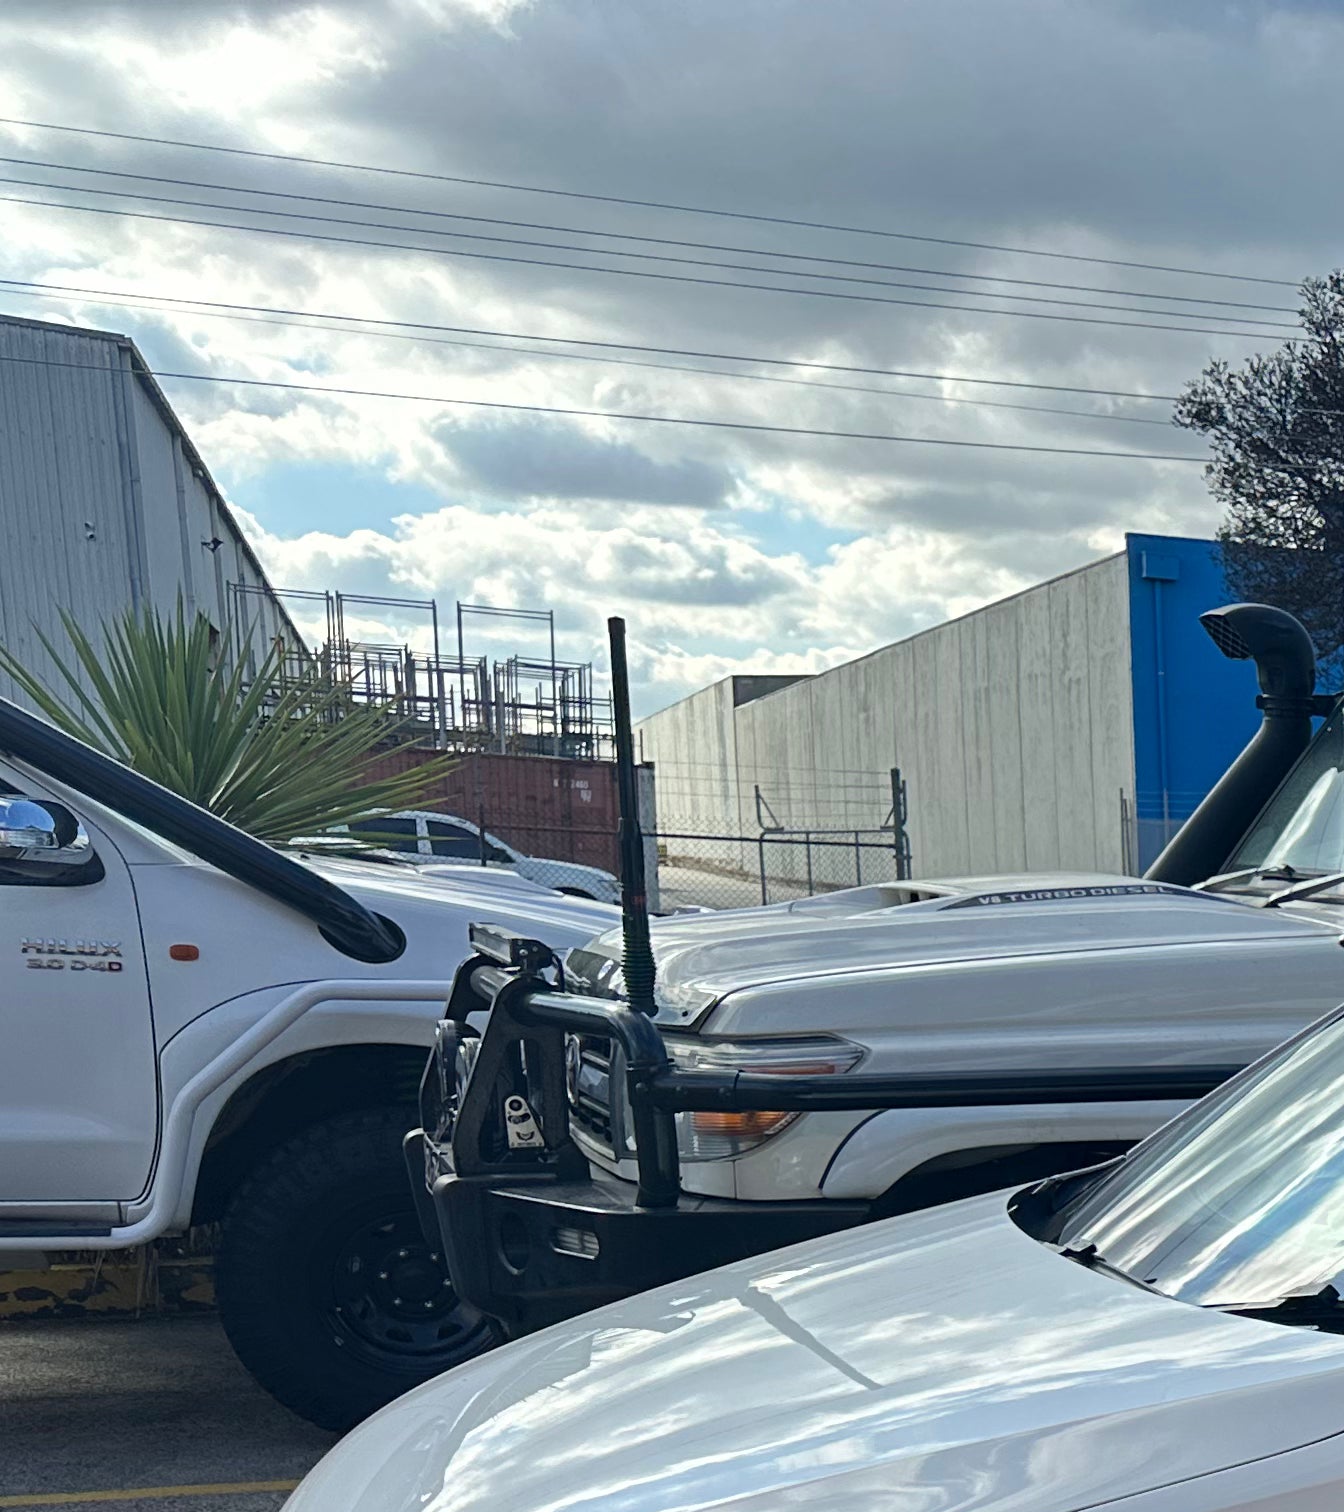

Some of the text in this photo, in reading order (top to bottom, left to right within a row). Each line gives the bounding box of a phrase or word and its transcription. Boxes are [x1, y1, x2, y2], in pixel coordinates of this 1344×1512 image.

[978, 886, 1171, 904] V8 TURBO DIESEL
[21, 939, 122, 956] HILUX
